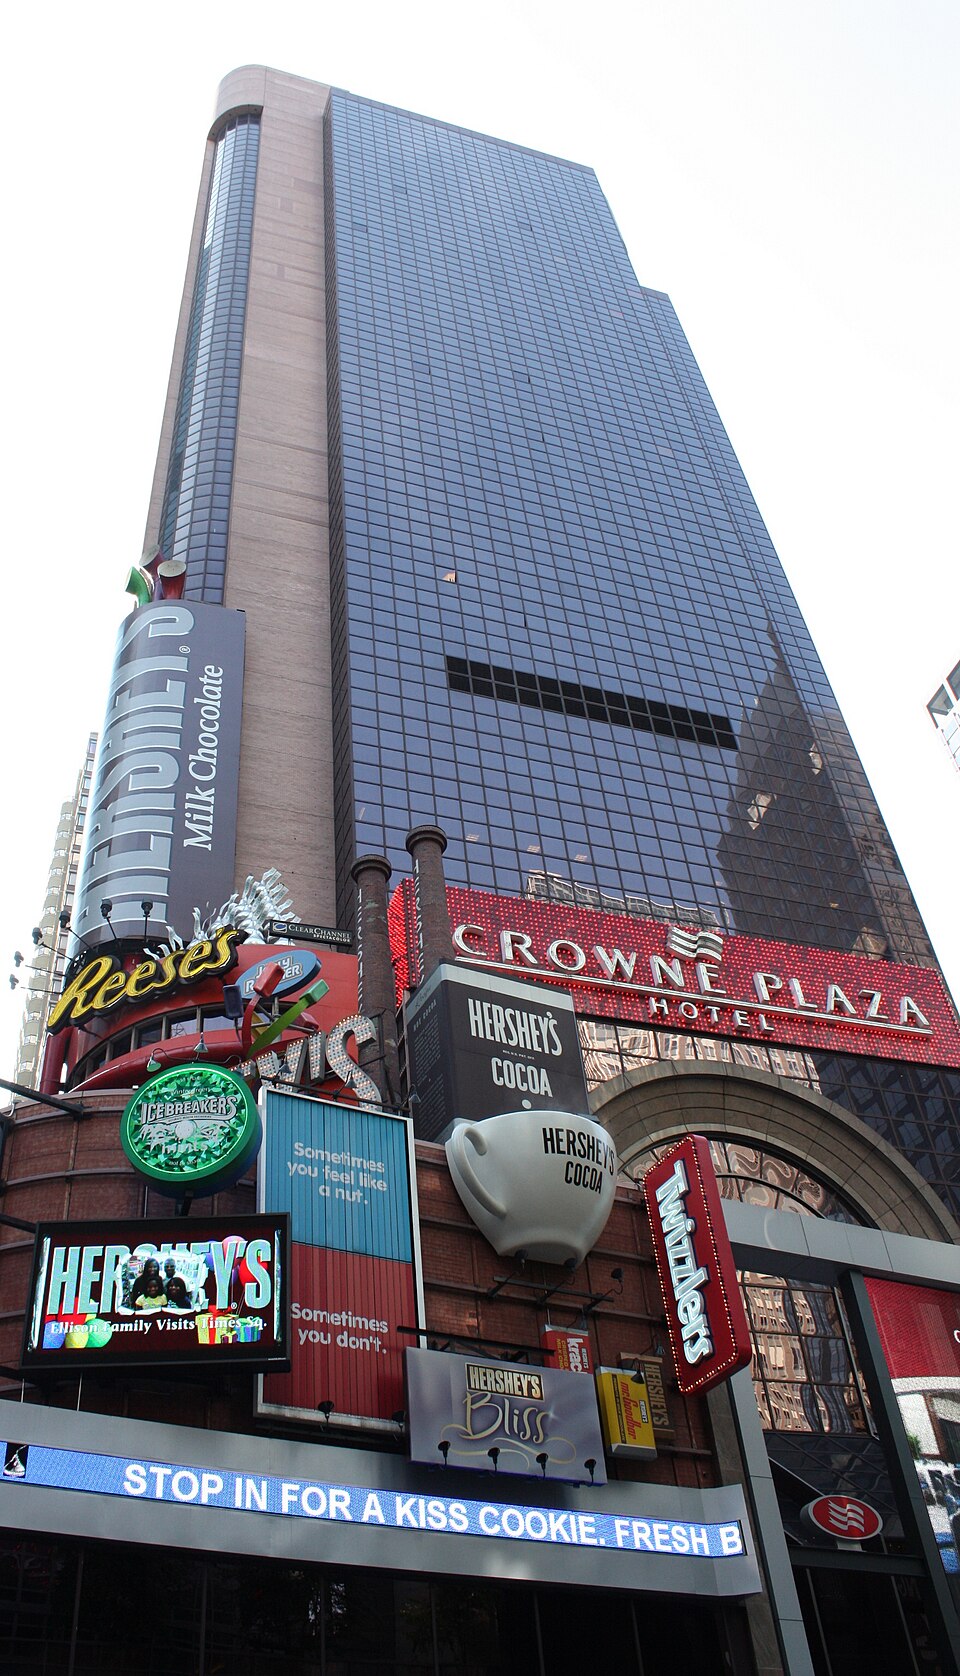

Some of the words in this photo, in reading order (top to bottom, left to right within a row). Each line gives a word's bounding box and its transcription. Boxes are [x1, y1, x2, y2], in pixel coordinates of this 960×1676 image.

[188, 664, 224, 782] Chocolate
[70, 605, 195, 938] HERSHEYS
[183, 786, 217, 852] Milk
[47, 926, 241, 1028] Reese's
[452, 923, 726, 995] CROWNE
[752, 971, 930, 1028] PLAZA
[467, 998, 563, 1056] HERSHEY'S
[650, 996, 775, 1033] HOTEL
[491, 1057, 553, 1098] COCOA
[294, 1142, 385, 1173] Sometimes
[542, 1127, 615, 1176] HERSHEY'S
[287, 1161, 318, 1177] you
[322, 1165, 355, 1185] feel
[359, 1171, 388, 1192] like
[318, 1184, 330, 1197] a
[335, 1188, 369, 1205] nut.
[564, 1160, 603, 1194] COCOA
[655, 1159, 714, 1365] Twizzlers
[50, 1319, 99, 1334] Ellison
[103, 1319, 152, 1336] Family
[156, 1318, 196, 1331] Visits
[201, 1317, 242, 1329] Times
[246, 1315, 268, 1331] Sq.
[291, 1302, 389, 1334] Sometimes
[298, 1328, 331, 1345] you
[336, 1330, 387, 1354] don't.
[567, 1337, 588, 1374] krac
[470, 1365, 541, 1398] HERSHEY'S
[645, 1363, 669, 1426] HERSHEY'S
[459, 1391, 549, 1444] Bliss
[123, 1464, 223, 1504] STOP
[235, 1477, 267, 1510] IN
[281, 1483, 352, 1520] FOR
[361, 1493, 386, 1523] A
[396, 1496, 469, 1533] KISS
[479, 1505, 605, 1545] COOKIE.
[615, 1519, 710, 1555] FRESH
